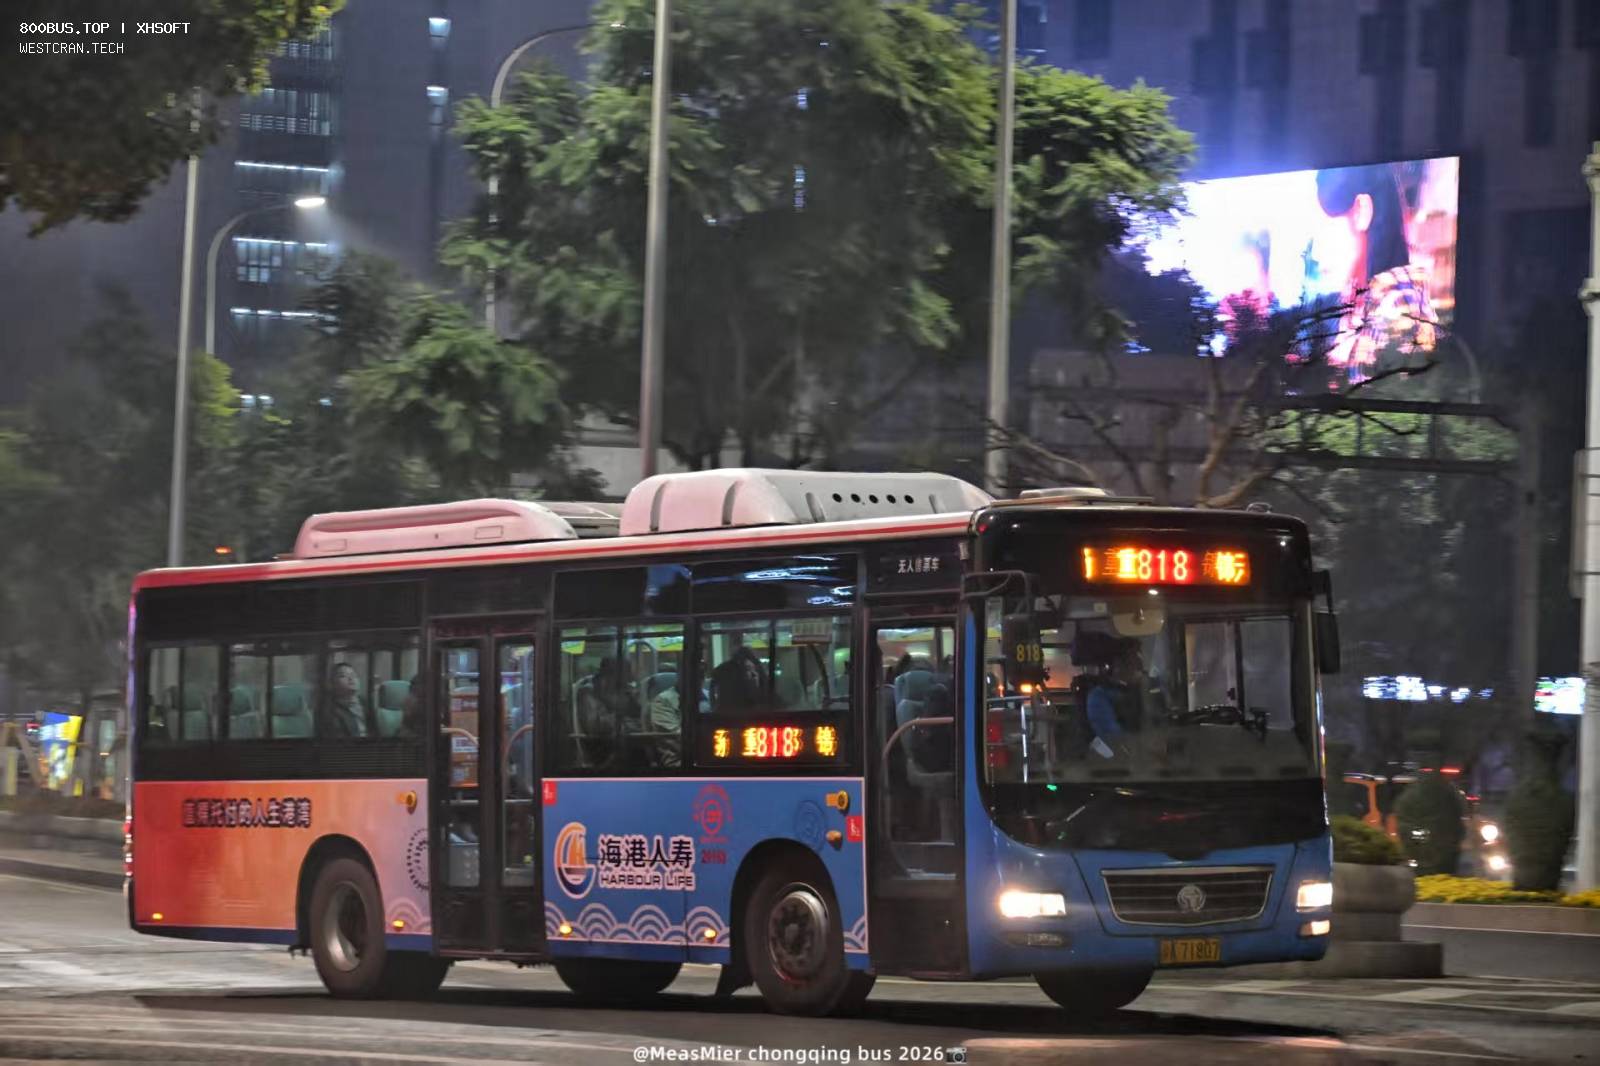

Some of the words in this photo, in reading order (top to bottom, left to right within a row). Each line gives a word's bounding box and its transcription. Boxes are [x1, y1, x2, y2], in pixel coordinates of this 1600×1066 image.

[1138, 549, 1188, 581] 818
[1016, 643, 1041, 663] 818
[600, 838, 694, 868] 海港人寿
[601, 875, 661, 887] HARBOUR
[666, 876, 694, 888] LIFE
